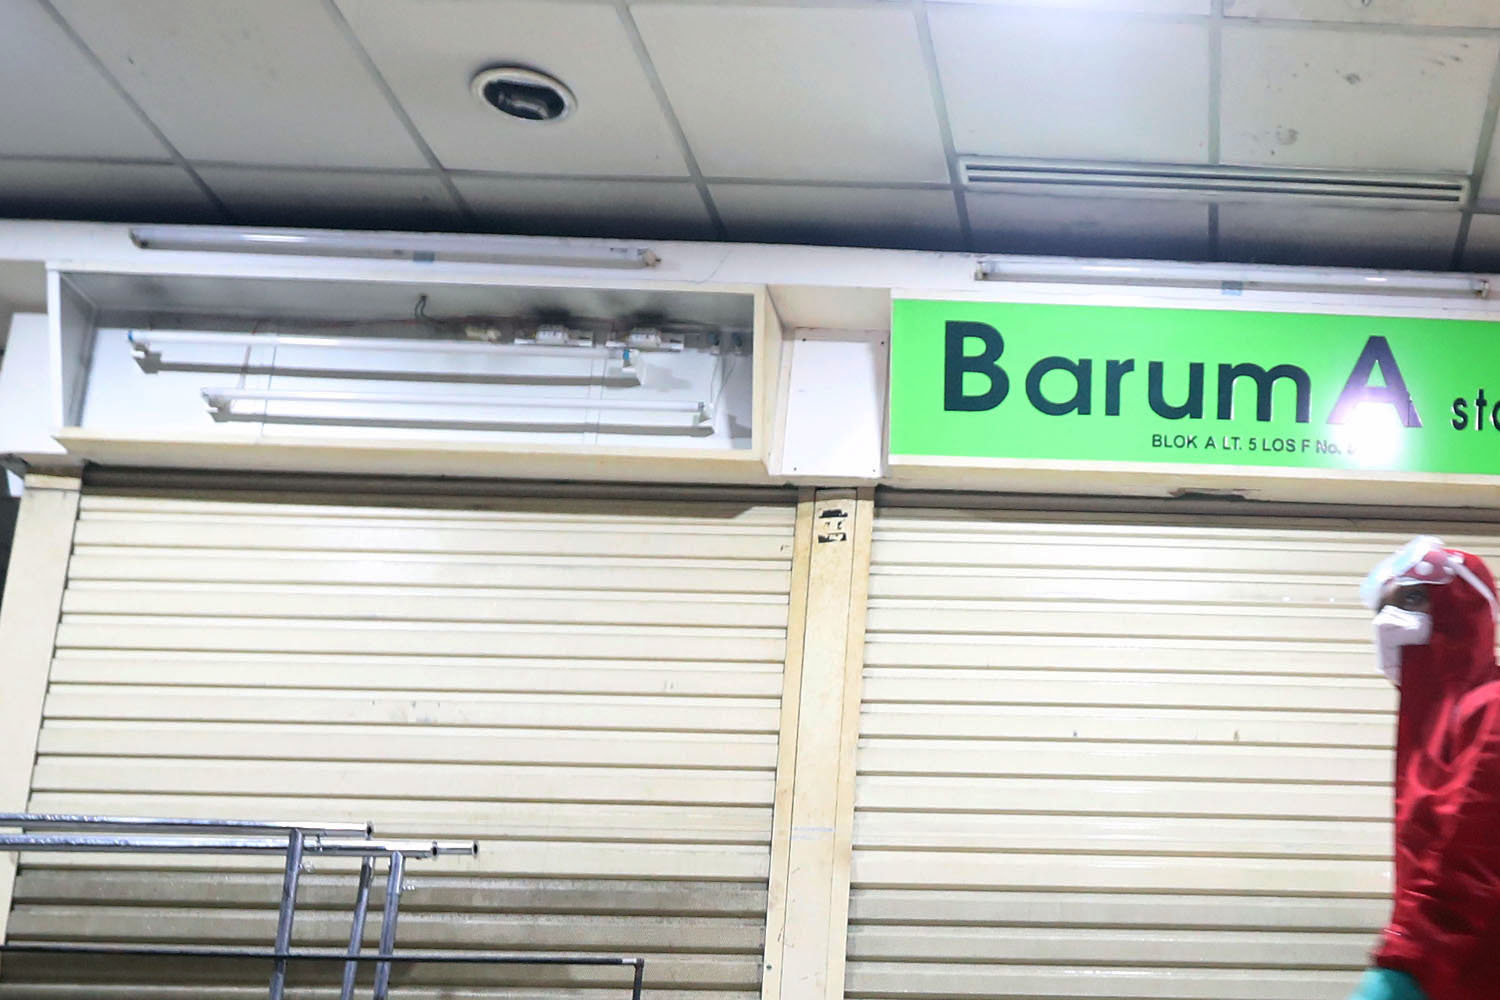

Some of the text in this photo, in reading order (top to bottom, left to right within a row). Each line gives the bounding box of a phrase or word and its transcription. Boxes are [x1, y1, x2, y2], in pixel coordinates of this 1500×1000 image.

[1151, 433, 1199, 449] BLOK
[1204, 436, 1217, 449] A
[1222, 436, 1242, 451] LT.
[1248, 437, 1258, 451] 5
[1262, 438, 1297, 453] LOS
[1301, 439, 1311, 453] F
[1315, 439, 1342, 454] No.
